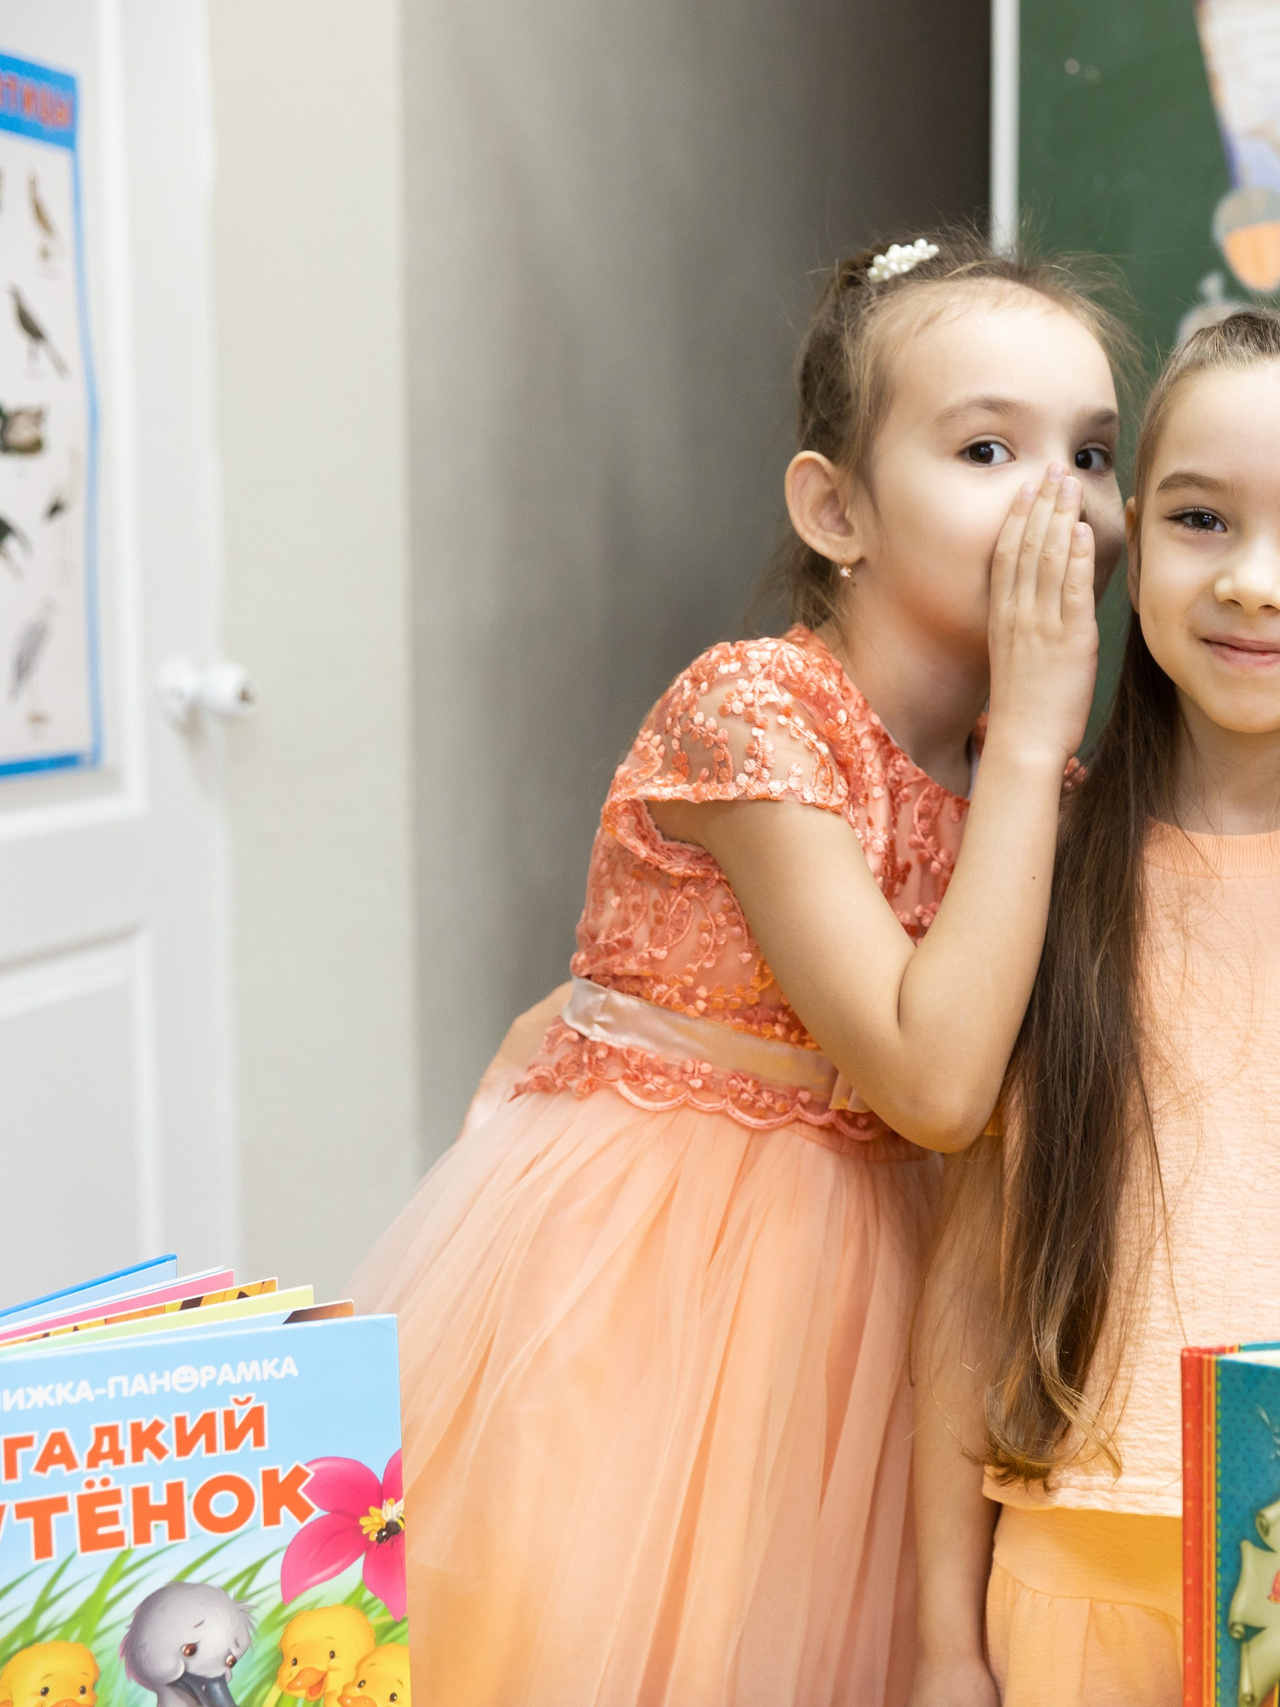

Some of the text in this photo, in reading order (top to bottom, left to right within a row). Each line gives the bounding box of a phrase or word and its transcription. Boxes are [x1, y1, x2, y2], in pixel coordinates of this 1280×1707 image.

[0, 1355, 299, 1412] ИЖКА-ПАНОРАМКА
[2, 1394, 268, 1483] ГАДКИЙ
[0, 1462, 317, 1563] ТЁНОК
